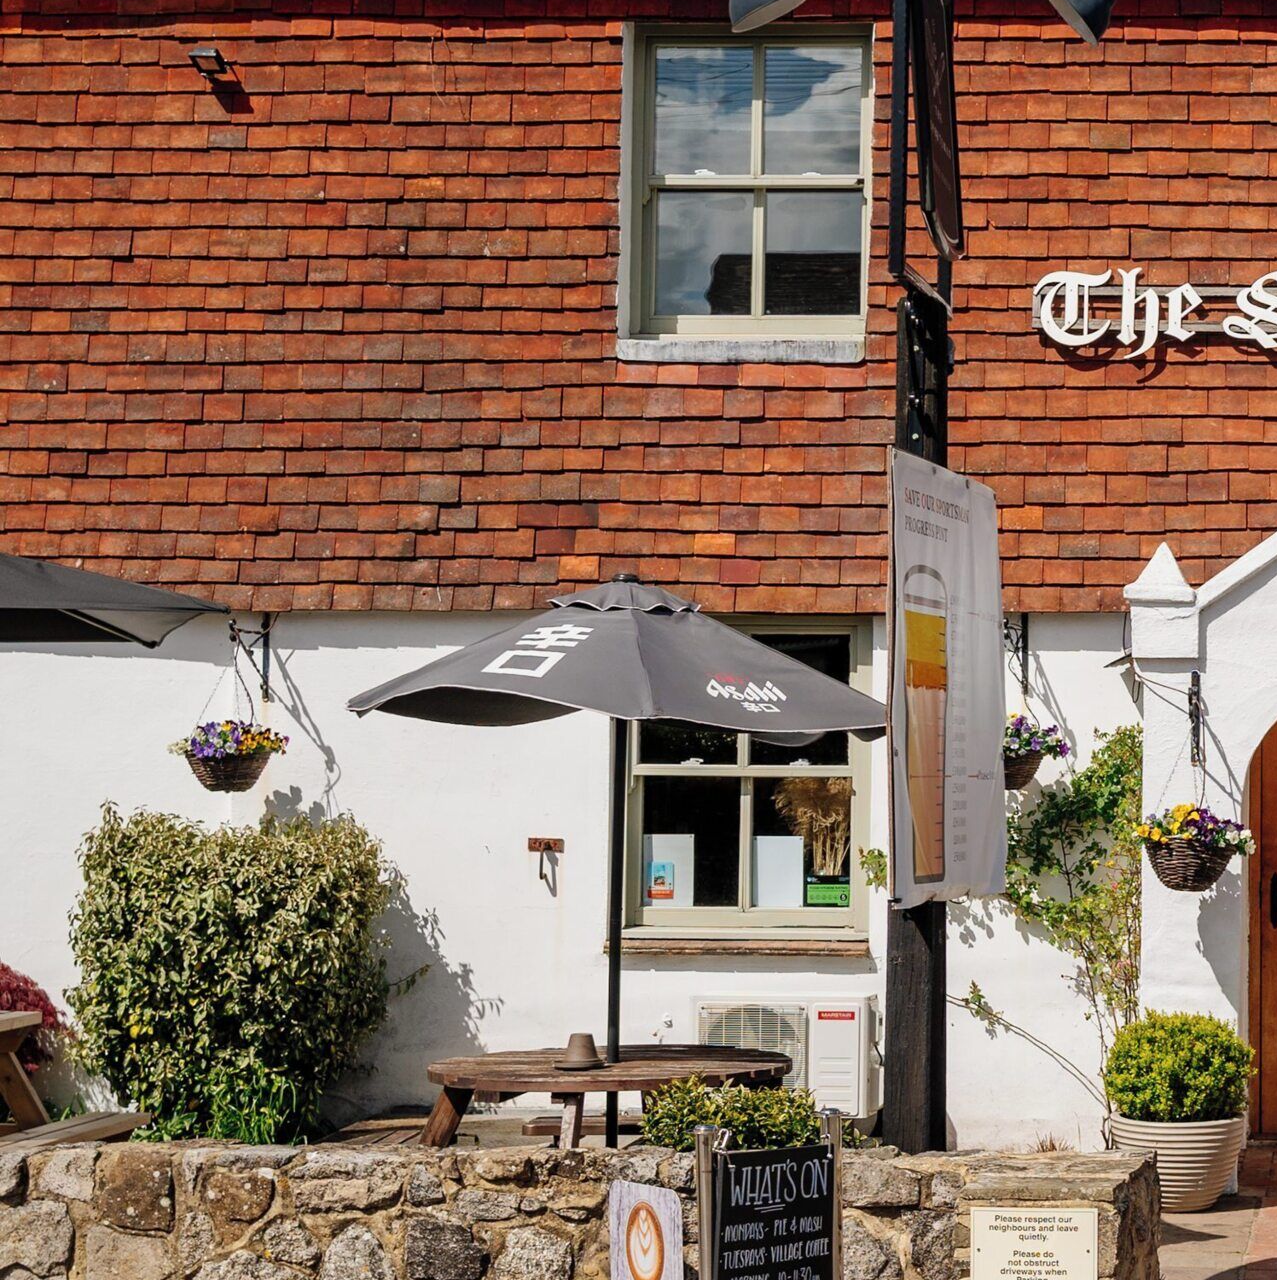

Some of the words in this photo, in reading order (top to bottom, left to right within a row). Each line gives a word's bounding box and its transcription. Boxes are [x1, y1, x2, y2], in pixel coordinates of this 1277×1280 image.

[1032, 267, 1203, 359] The
[904, 487, 920, 507] SAVE
[921, 493, 935, 512] OUR
[904, 515, 935, 538] PROGRESS
[935, 525, 948, 543] PINT
[730, 1159, 797, 1206] WHAT'S
[800, 1159, 829, 1198] ON
[774, 1219, 787, 1237] PIE
[790, 1216, 798, 1234] &
[800, 1215, 823, 1233] MASH
[989, 1223, 1036, 1233] neighbours
[994, 1214, 1022, 1223] Please
[1024, 1216, 1056, 1224] respect
[1019, 1233, 1049, 1242] quietly.
[771, 1242, 804, 1263] VILLAGE
[805, 1238, 830, 1258] COFFEE
[1013, 1250, 1041, 1258] Please
[1000, 1268, 1042, 1276] driveways
